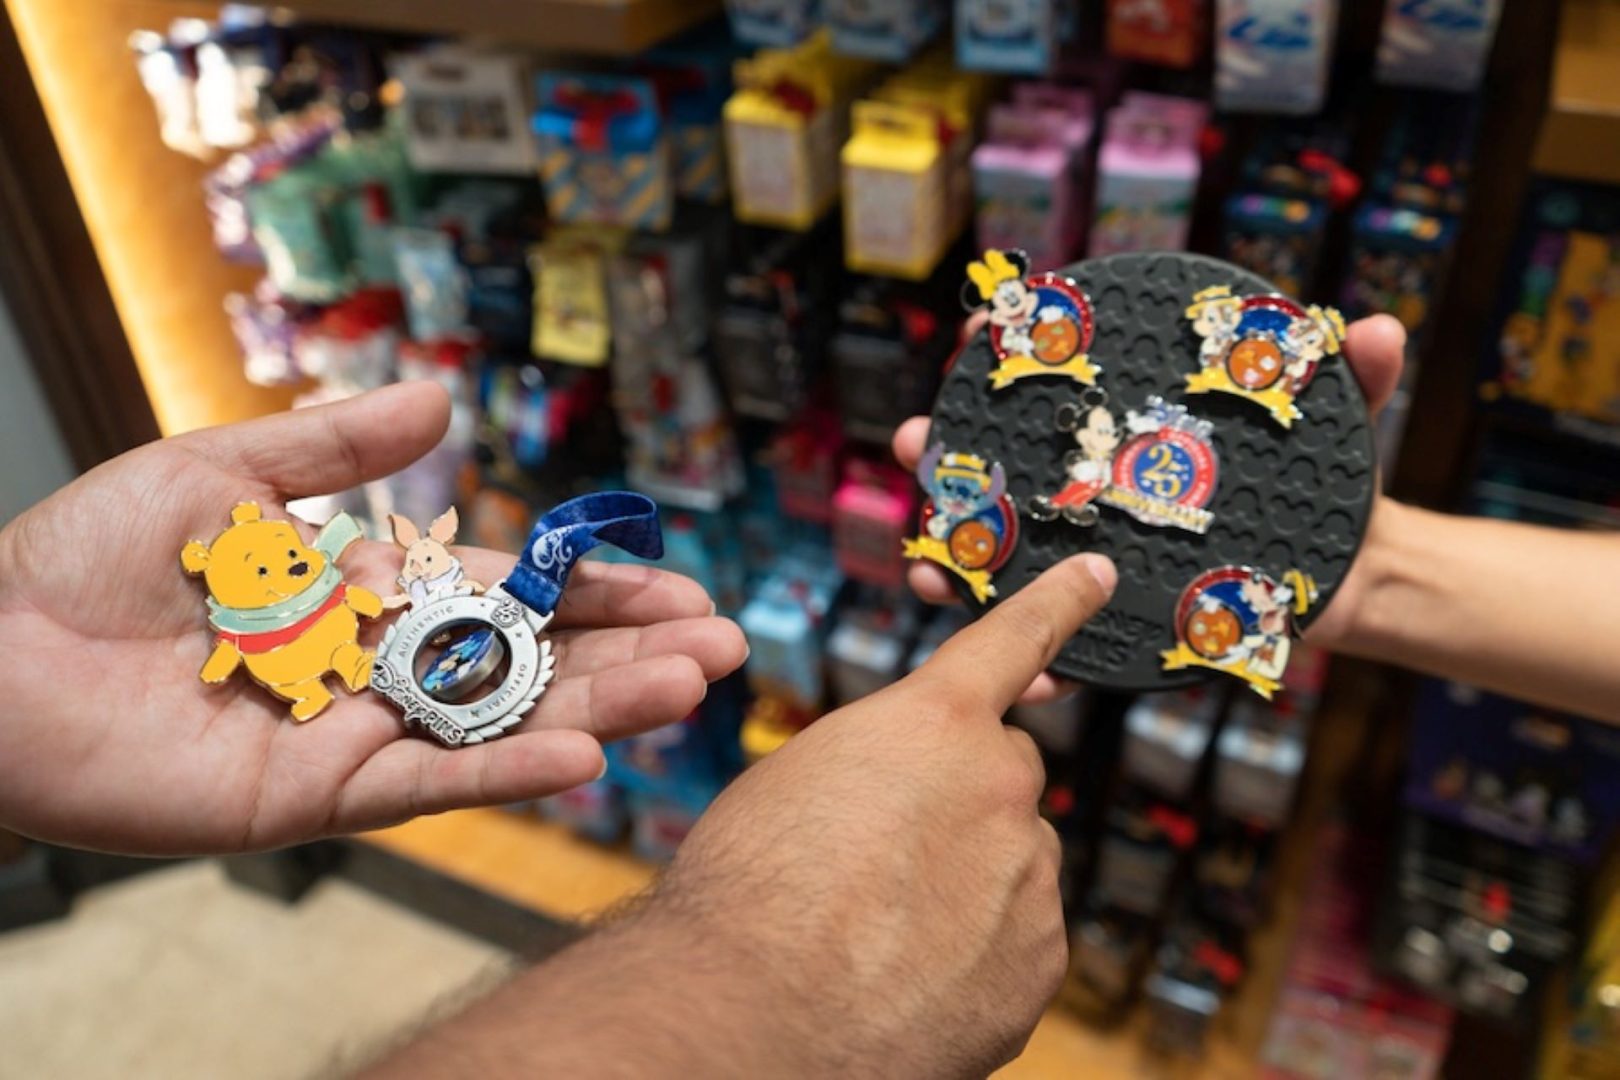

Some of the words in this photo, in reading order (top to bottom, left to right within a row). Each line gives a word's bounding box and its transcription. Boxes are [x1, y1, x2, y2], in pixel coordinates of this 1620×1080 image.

[1140, 443, 1184, 498] 25
[397, 604, 455, 658] AUTHENTIC
[485, 663, 527, 712] OFFICIAL
[421, 708, 466, 744] PINS
